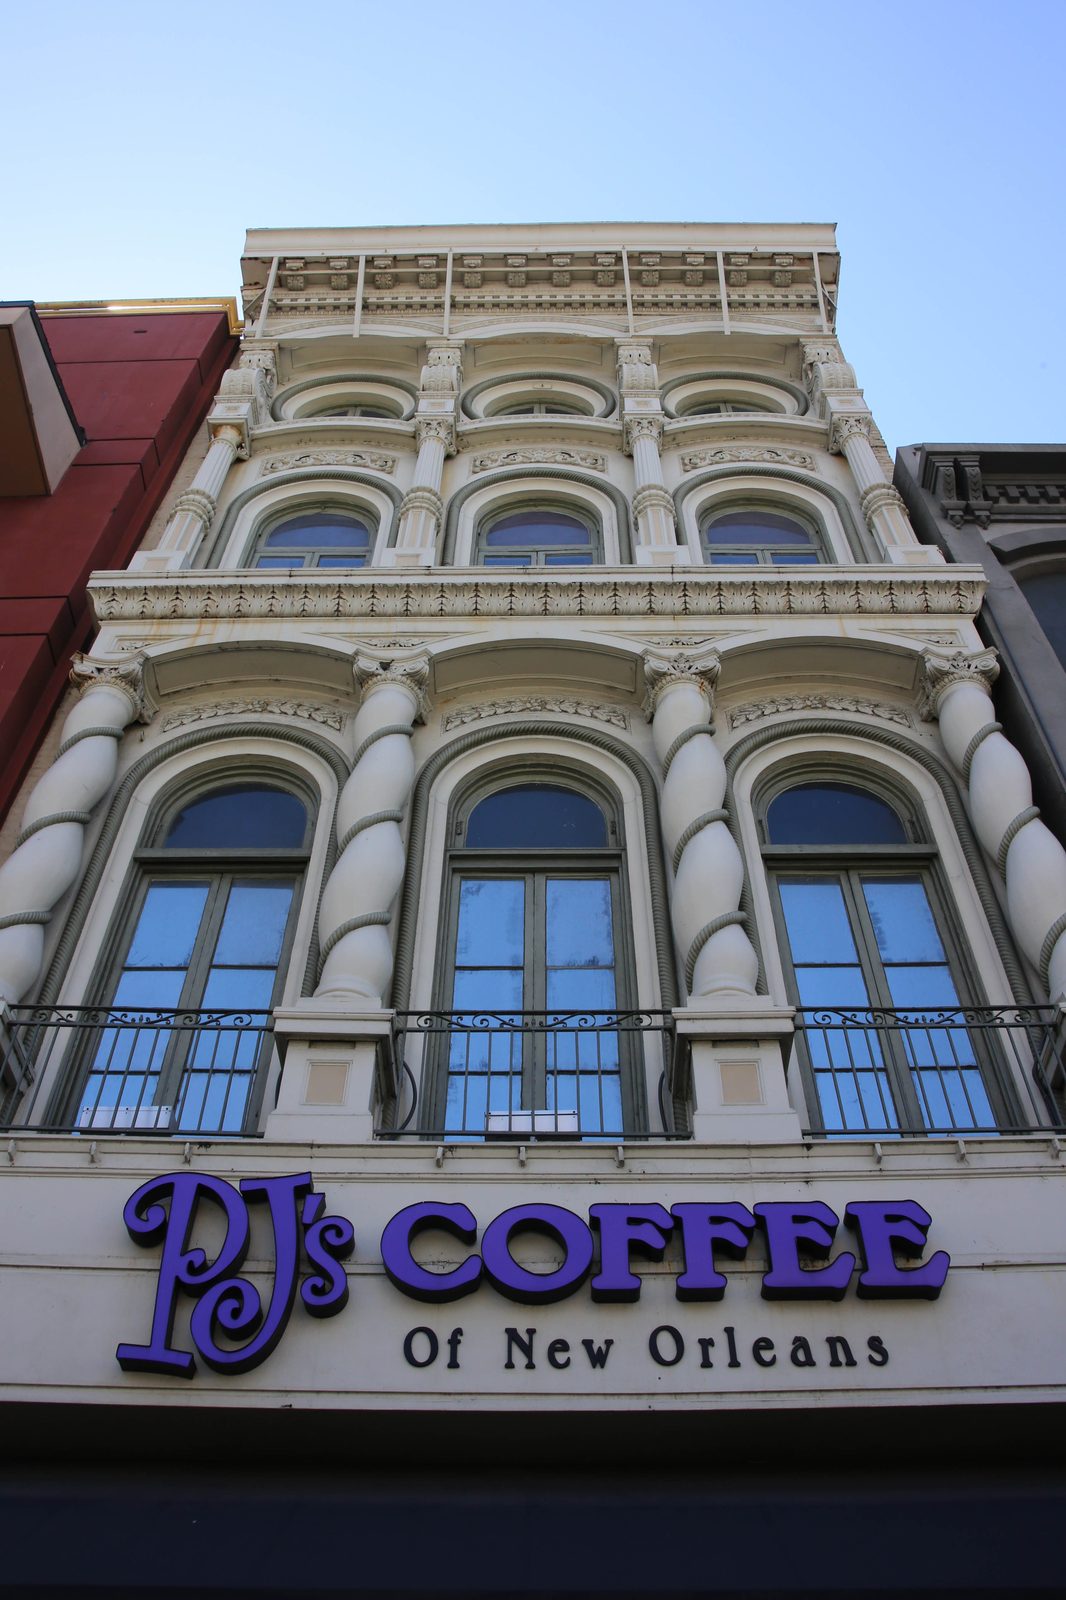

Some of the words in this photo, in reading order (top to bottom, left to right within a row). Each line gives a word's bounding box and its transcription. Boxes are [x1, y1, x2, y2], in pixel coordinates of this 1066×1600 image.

[117, 1172, 355, 1379] PJ's
[381, 1200, 951, 1305] COFFEE
[403, 1326, 464, 1369] Of
[504, 1327, 615, 1370] New
[649, 1324, 890, 1369] Orleans
